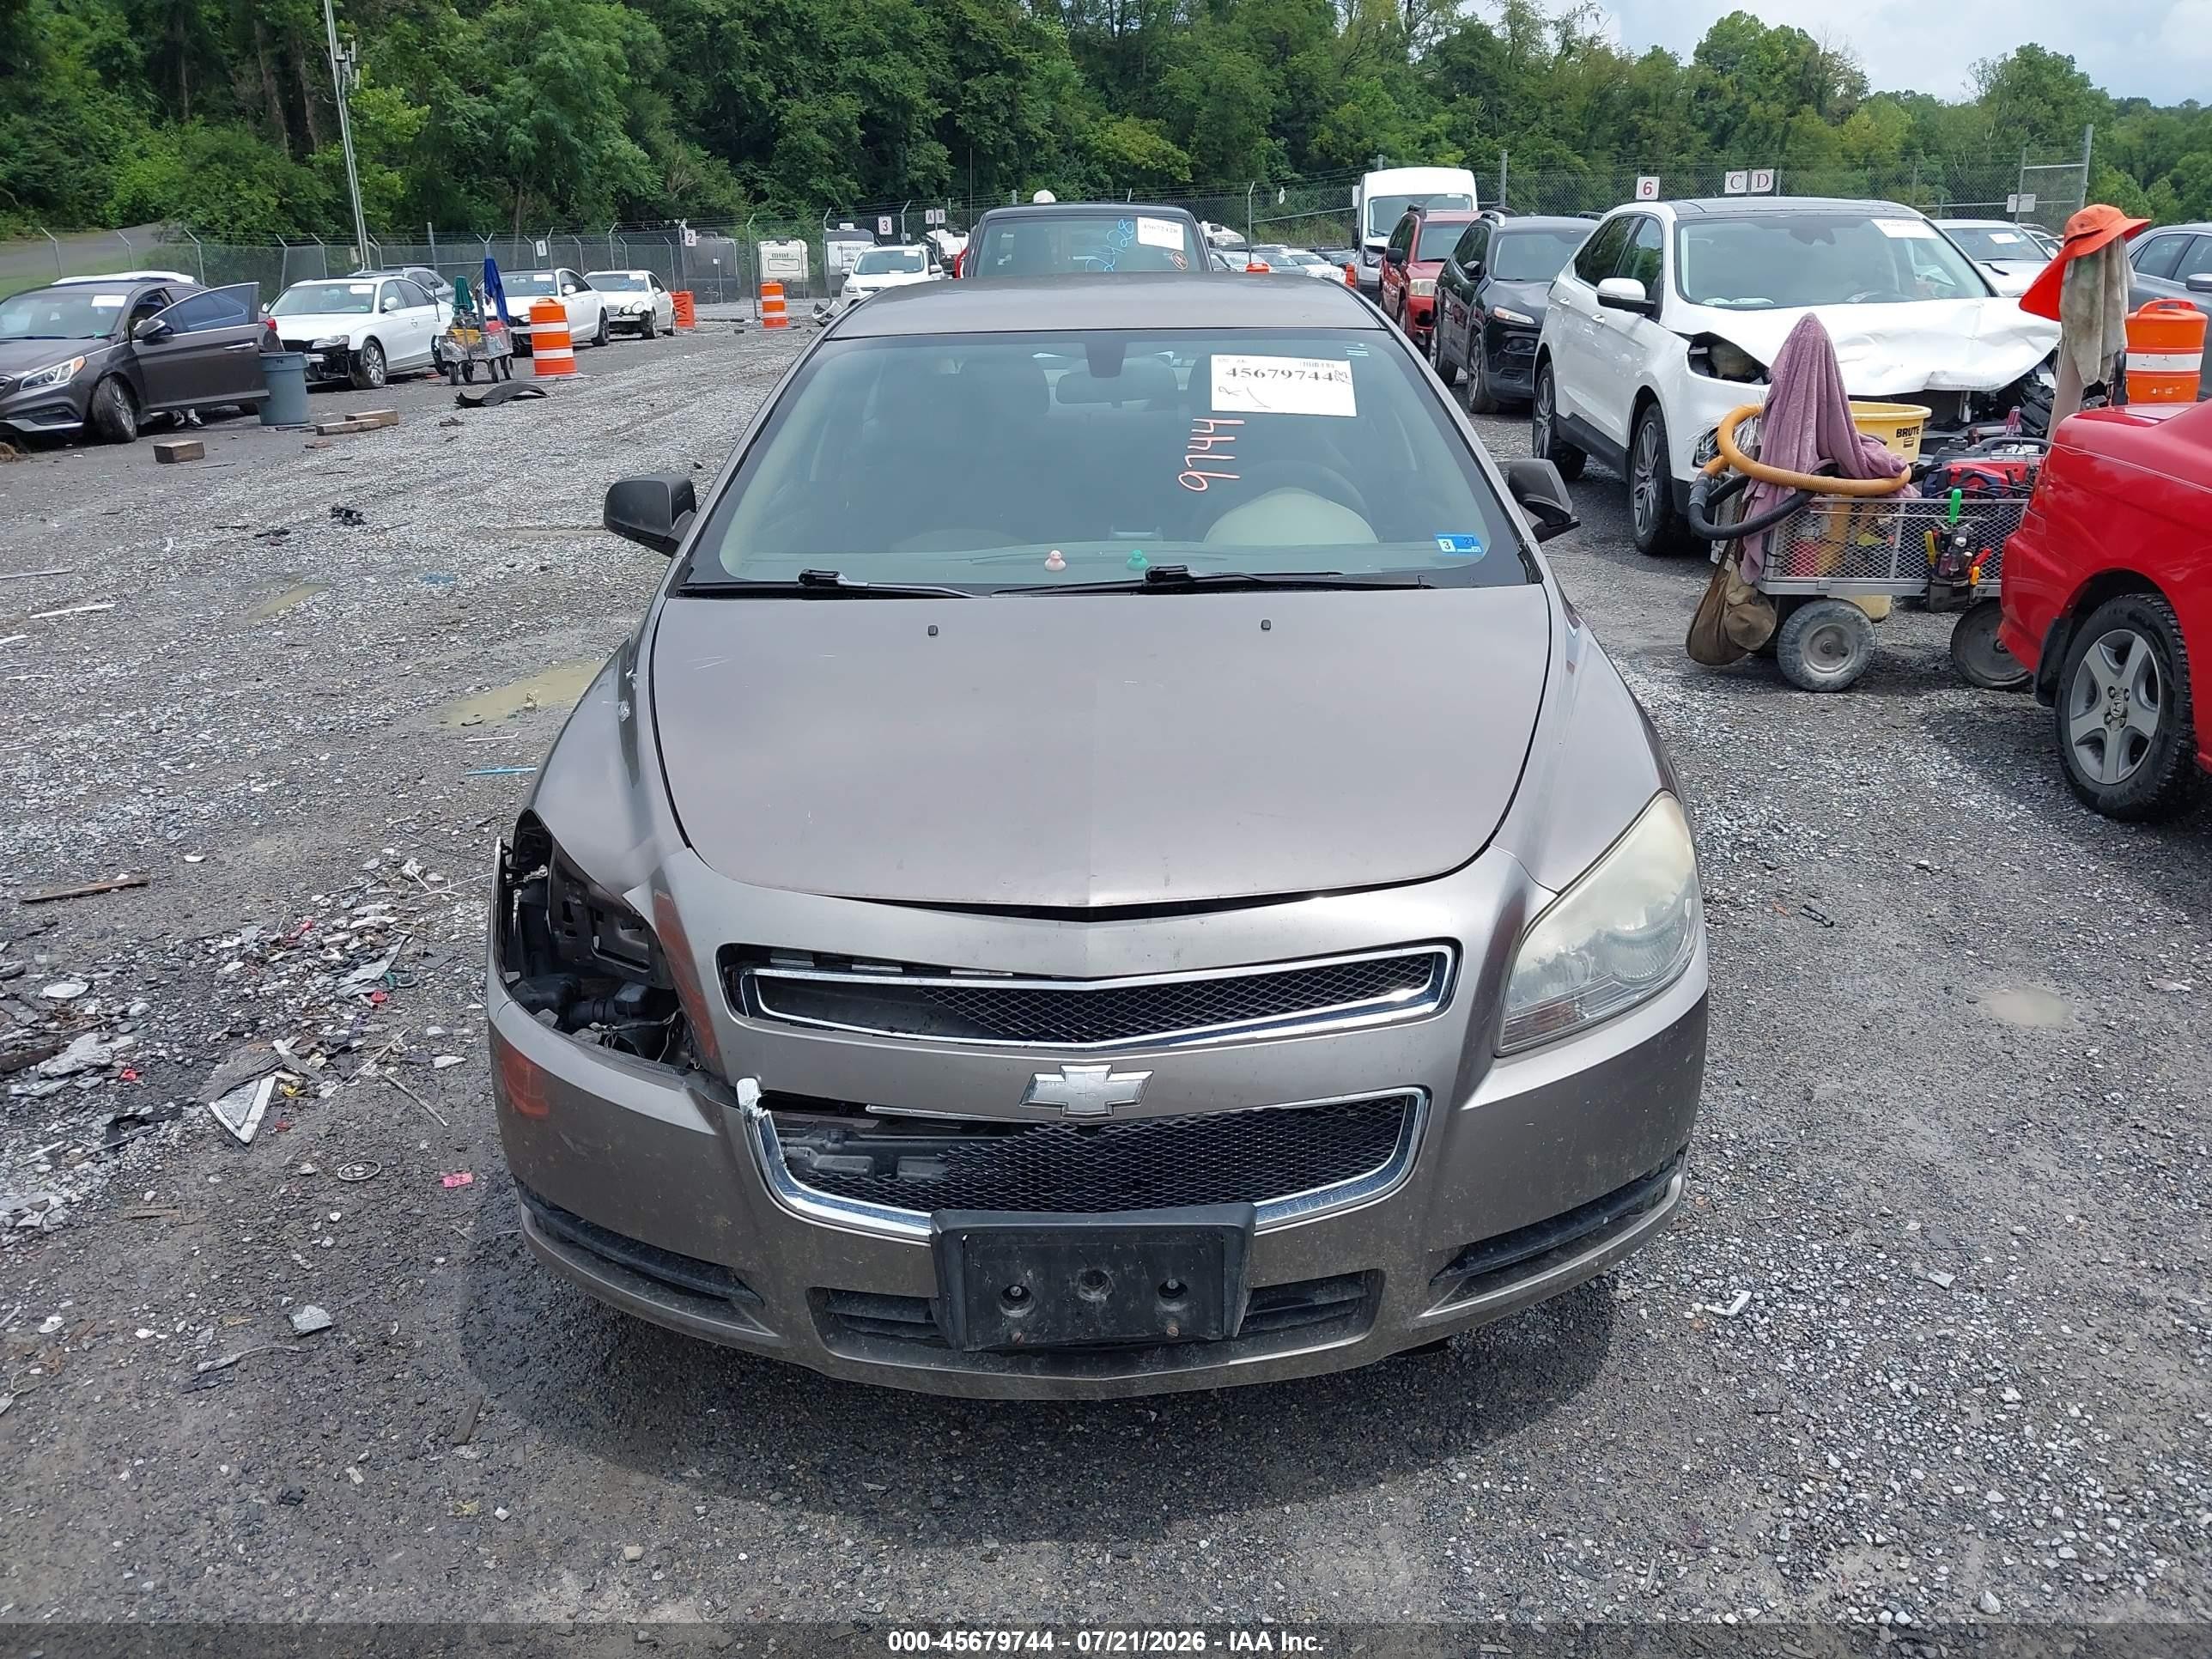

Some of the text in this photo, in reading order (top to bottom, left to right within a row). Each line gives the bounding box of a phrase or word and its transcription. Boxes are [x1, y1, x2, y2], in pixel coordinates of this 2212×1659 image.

[1730, 173, 1769, 189] C D
[1643, 181, 1652, 196] 6
[882, 220, 889, 232] 3
[687, 233, 693, 244] 2
[539, 243, 544, 254] 1
[1225, 367, 1334, 382] 45679744
[1895, 425, 1920, 438] BRUTE
[1178, 418, 1245, 490] 9744
[1443, 540, 1451, 550] 3
